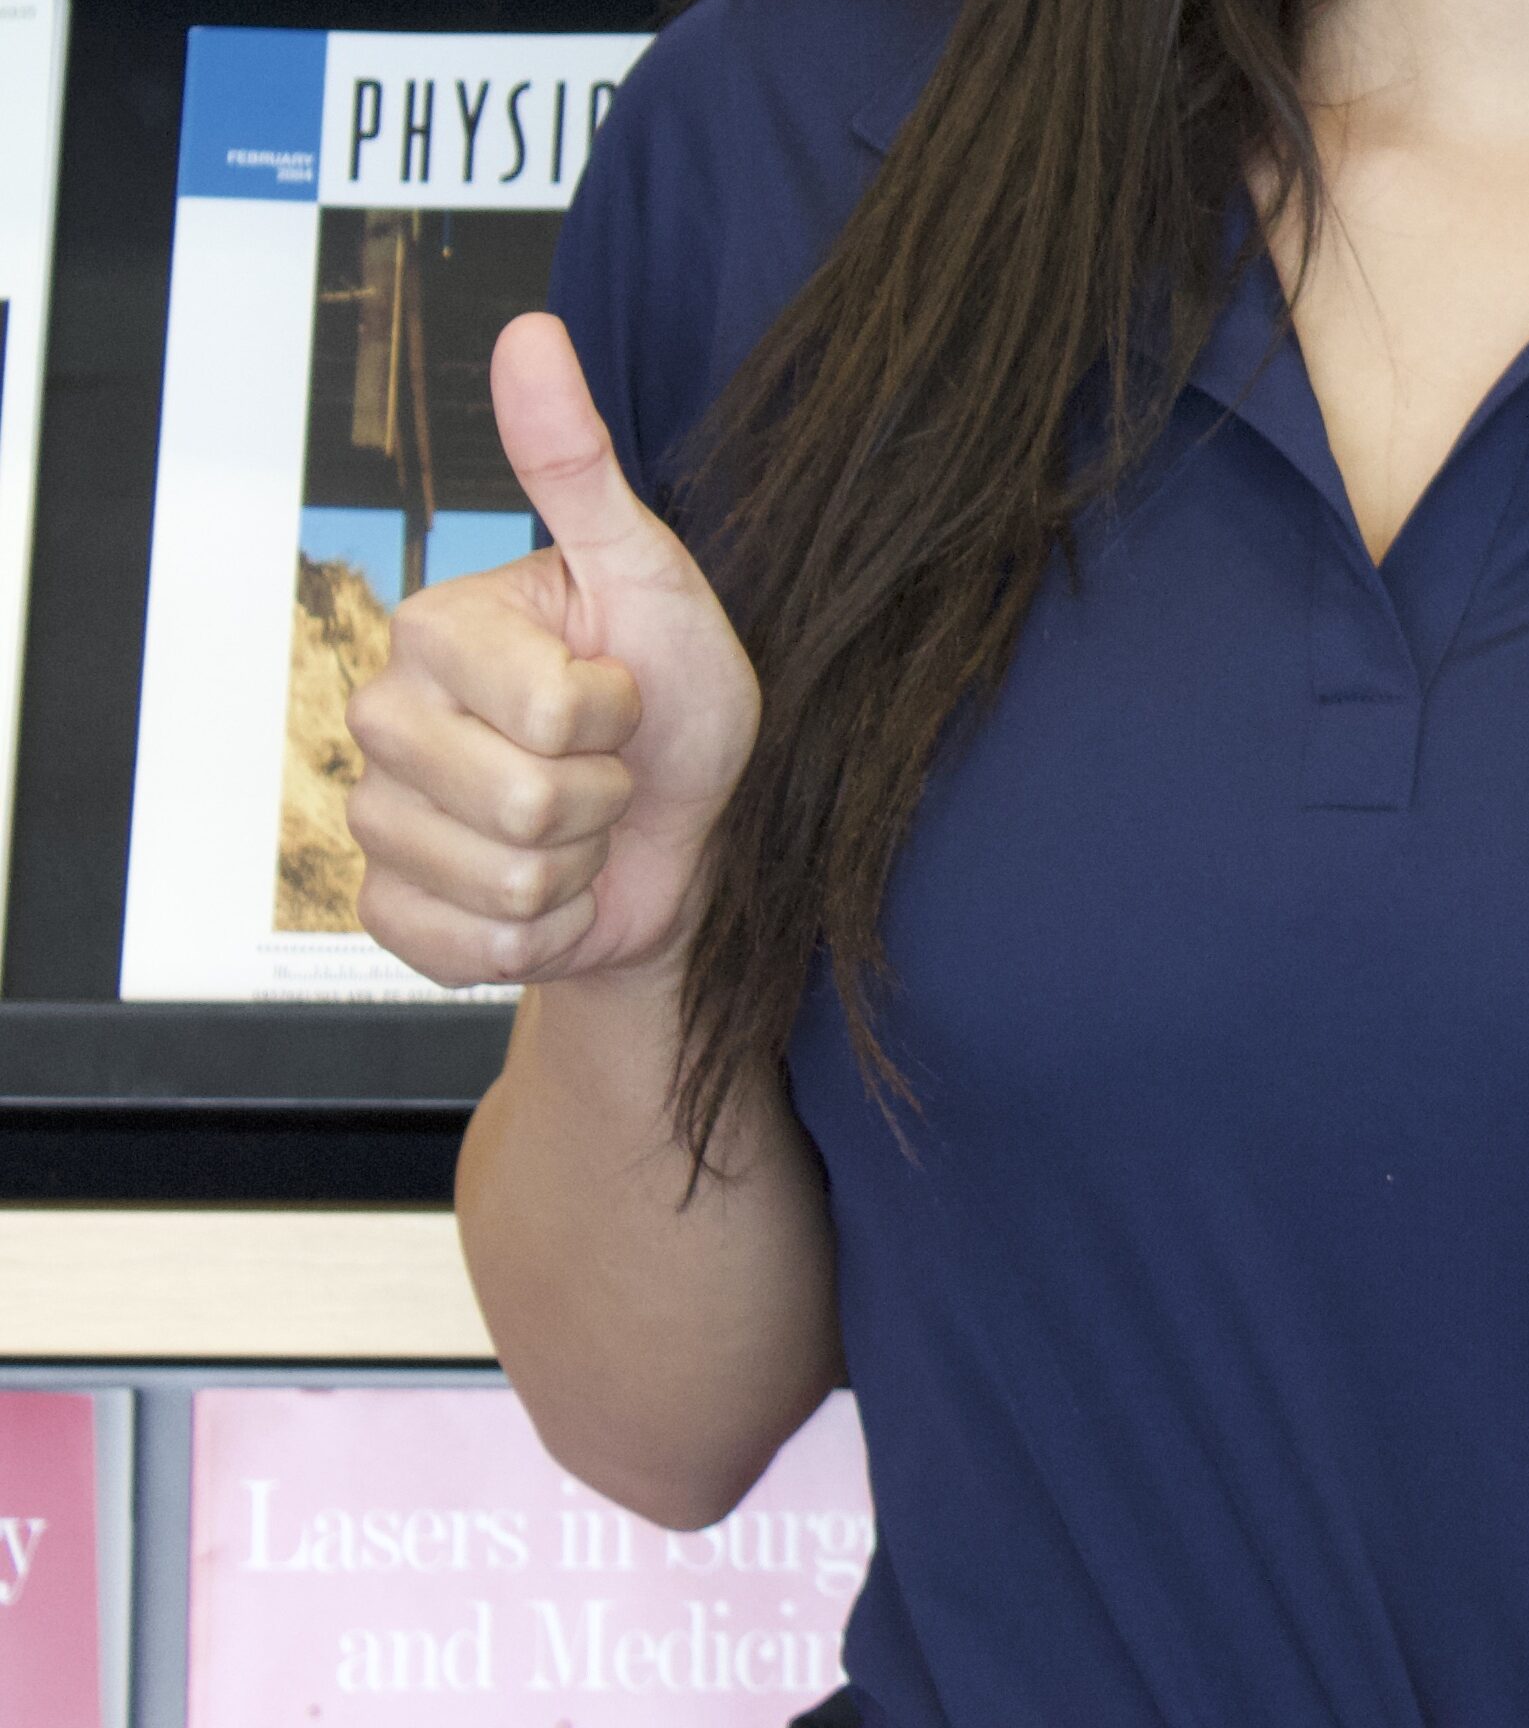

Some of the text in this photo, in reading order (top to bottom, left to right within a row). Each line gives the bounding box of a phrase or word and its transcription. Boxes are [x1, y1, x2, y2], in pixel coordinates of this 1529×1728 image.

[226, 149, 313, 167] FEBRUARY
[239, 1477, 876, 1598] Lasers in urg
[335, 1598, 497, 1694] and
